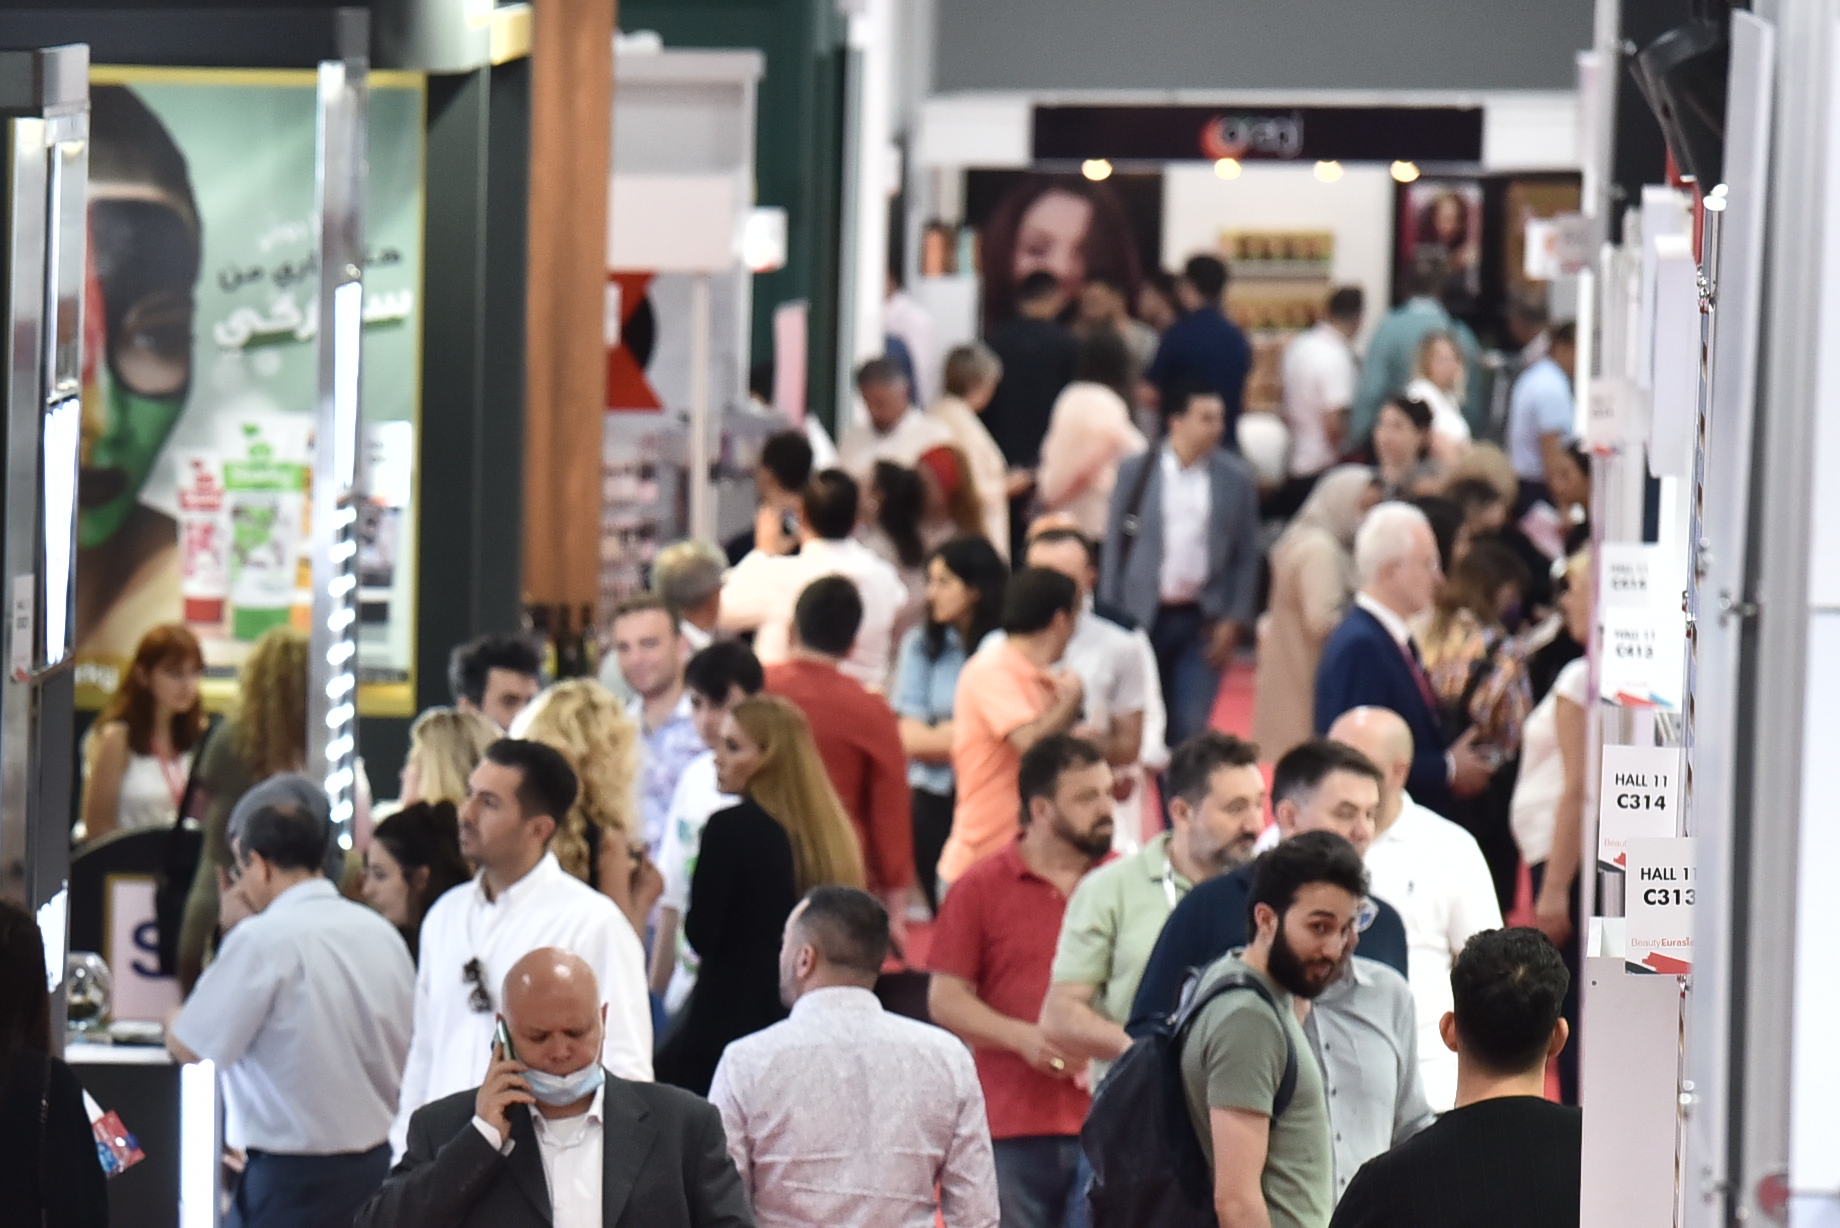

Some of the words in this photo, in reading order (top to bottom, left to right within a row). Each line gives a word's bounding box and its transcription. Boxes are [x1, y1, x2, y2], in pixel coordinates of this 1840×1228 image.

[1615, 773, 1648, 788] HALL
[1653, 775, 1668, 788] 11
[1616, 794, 1667, 811] C314
[1640, 867, 1677, 881] HALL
[1643, 889, 1697, 906] C313
